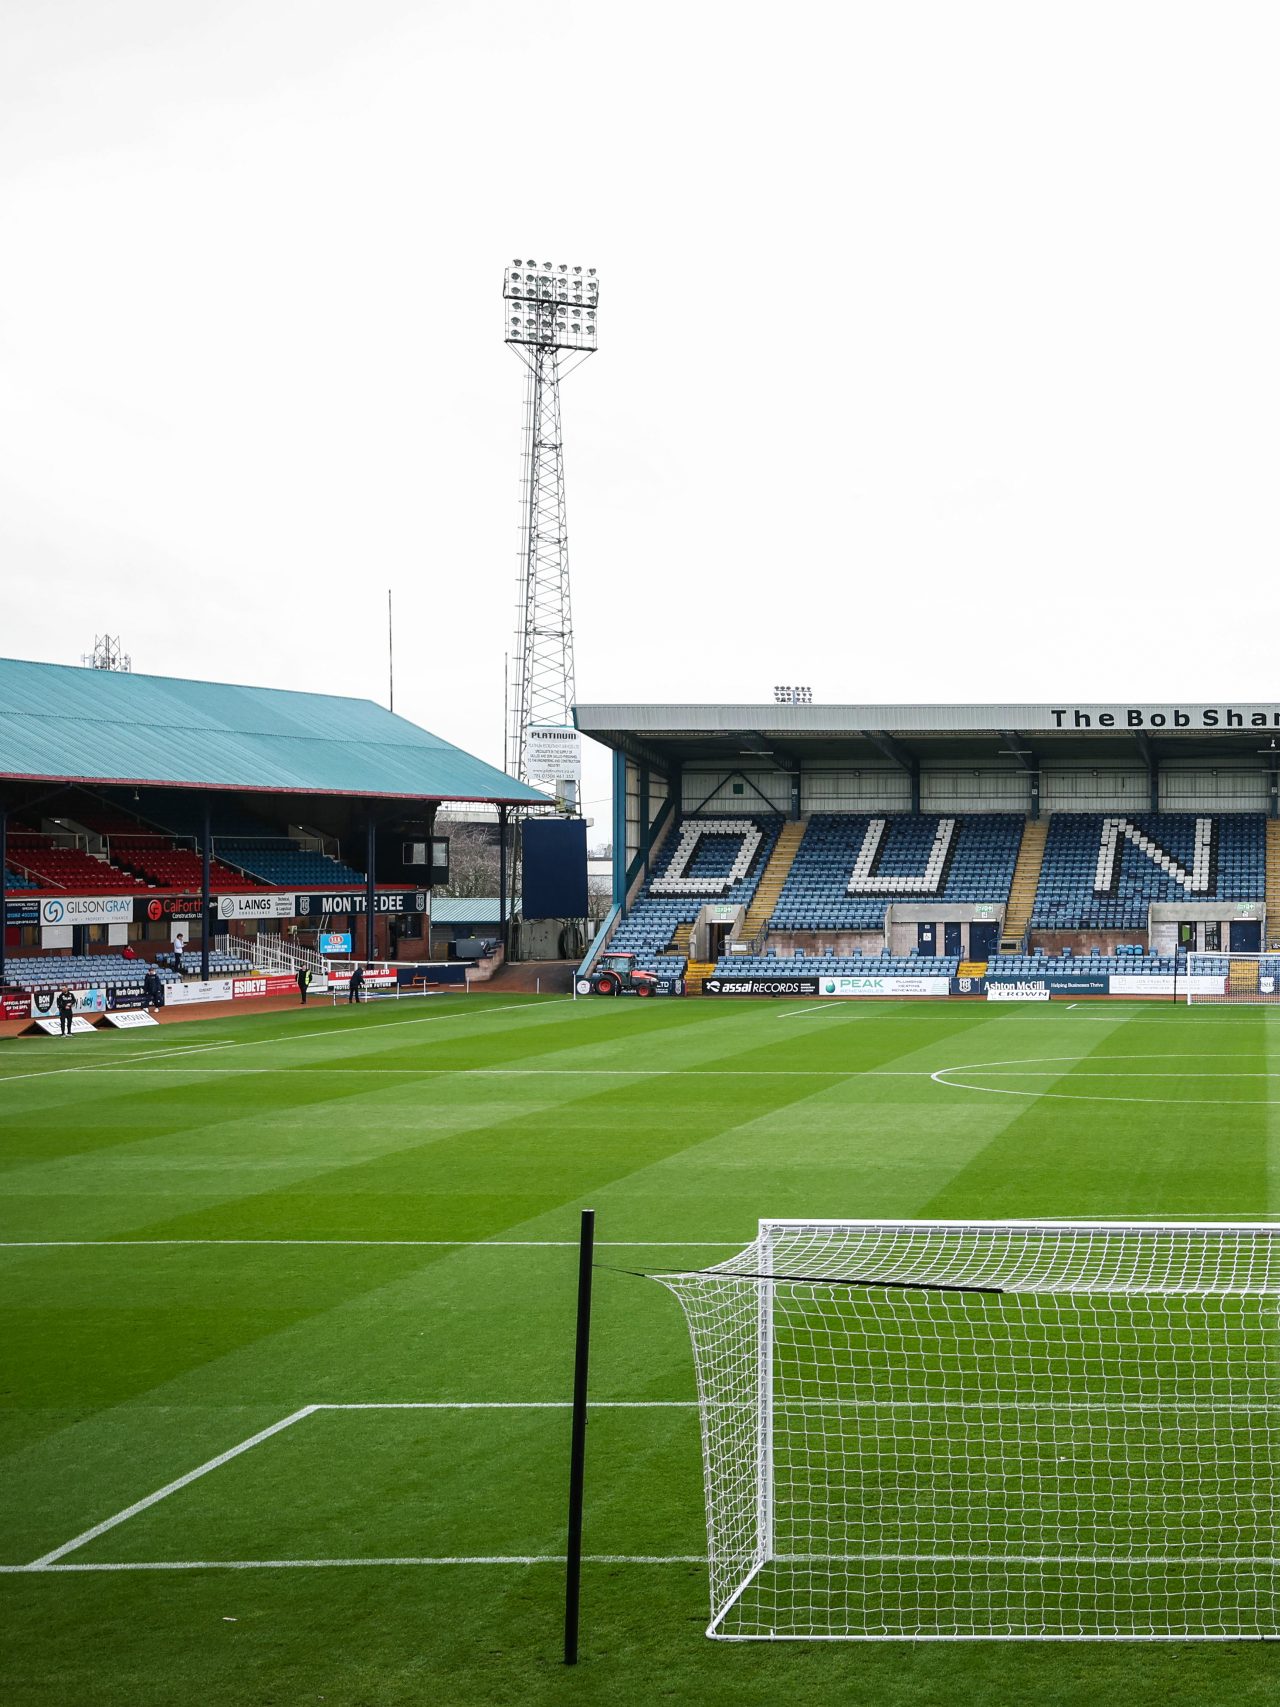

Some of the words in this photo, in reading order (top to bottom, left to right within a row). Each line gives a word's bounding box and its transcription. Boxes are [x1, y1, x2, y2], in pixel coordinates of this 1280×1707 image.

[1051, 709, 1115, 727] The
[1127, 709, 1191, 727] Bob
[239, 899, 271, 910] LAINGS
[322, 897, 351, 913] MON
[380, 895, 403, 911] DEE
[240, 980, 260, 993] SIDEY
[722, 980, 753, 993] assai
[753, 982, 799, 993] RECORDS
[840, 979, 884, 988] PEAK
[984, 981, 1015, 990] Ashton
[1016, 980, 1045, 990] McGill
